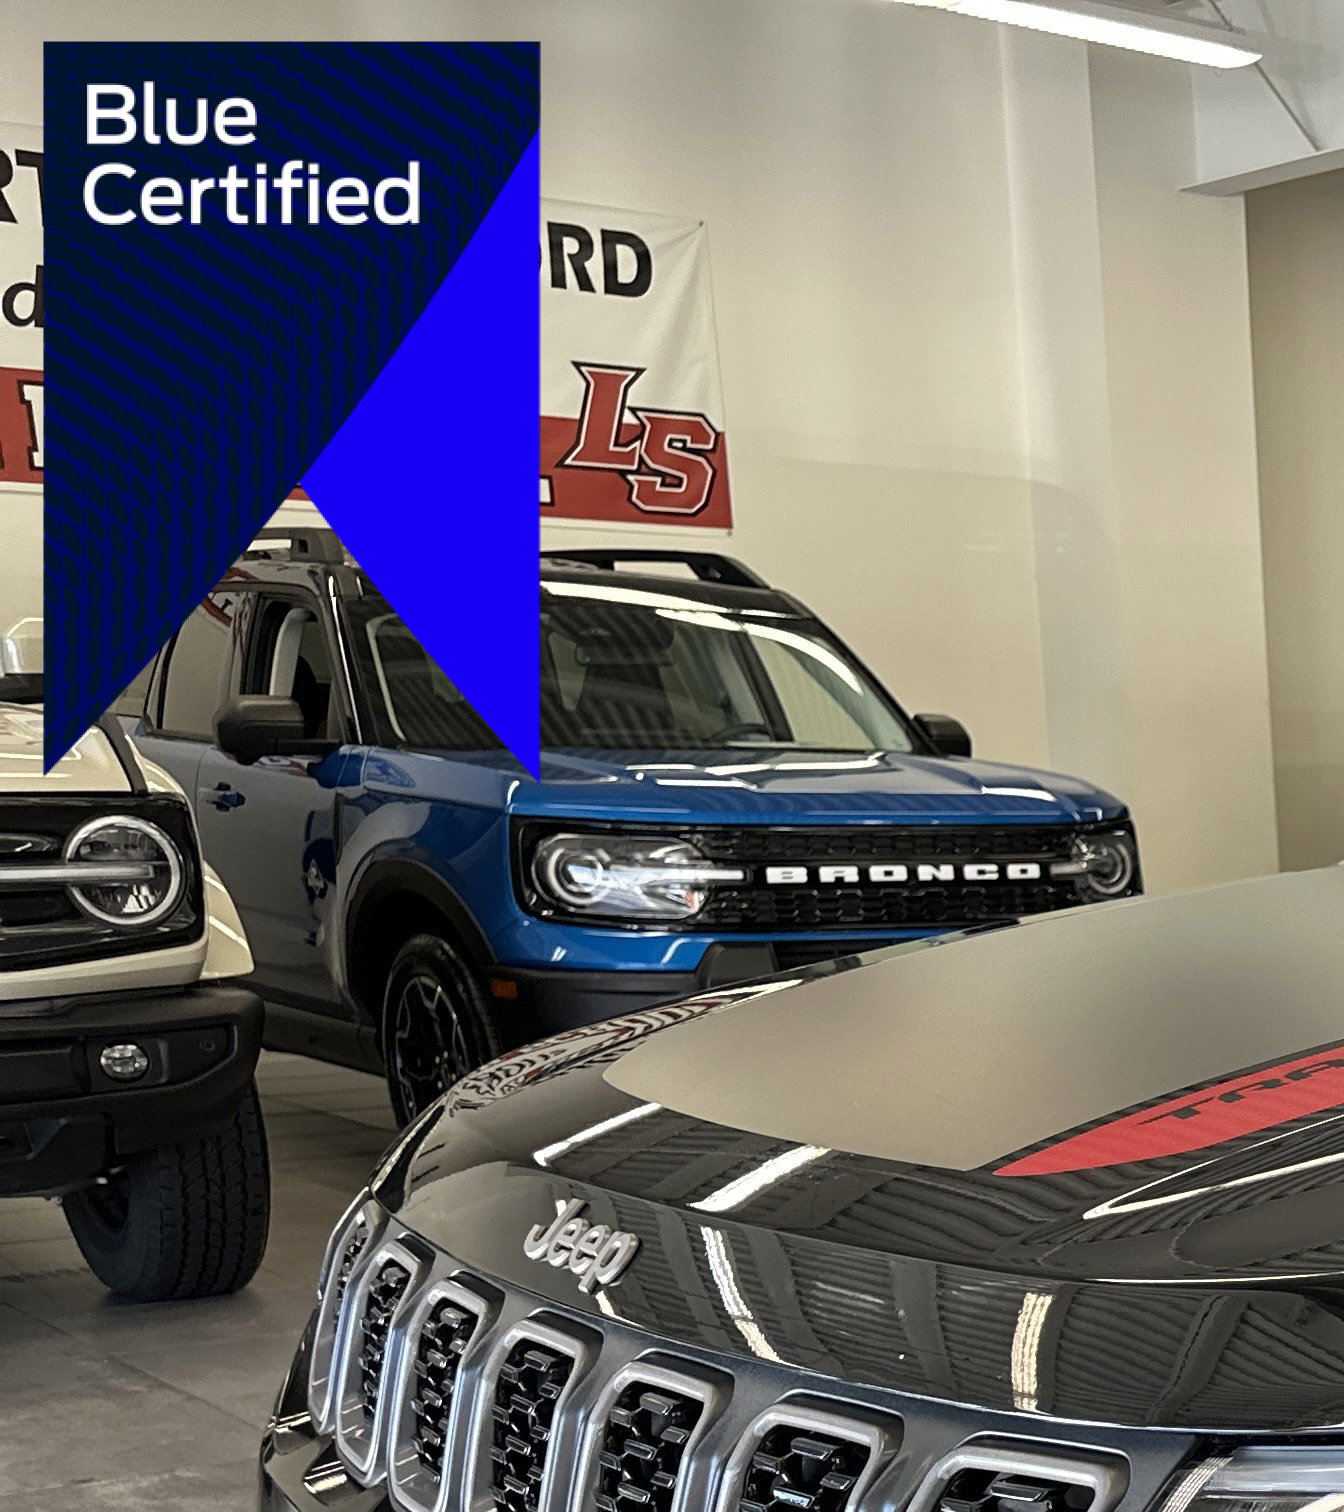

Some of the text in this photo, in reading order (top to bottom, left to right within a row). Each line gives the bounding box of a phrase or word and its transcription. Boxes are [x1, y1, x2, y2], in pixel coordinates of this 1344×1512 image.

[540, 220, 652, 298] RD
[765, 862, 1042, 884] BRONCO
[523, 1197, 641, 1294] Jeep
